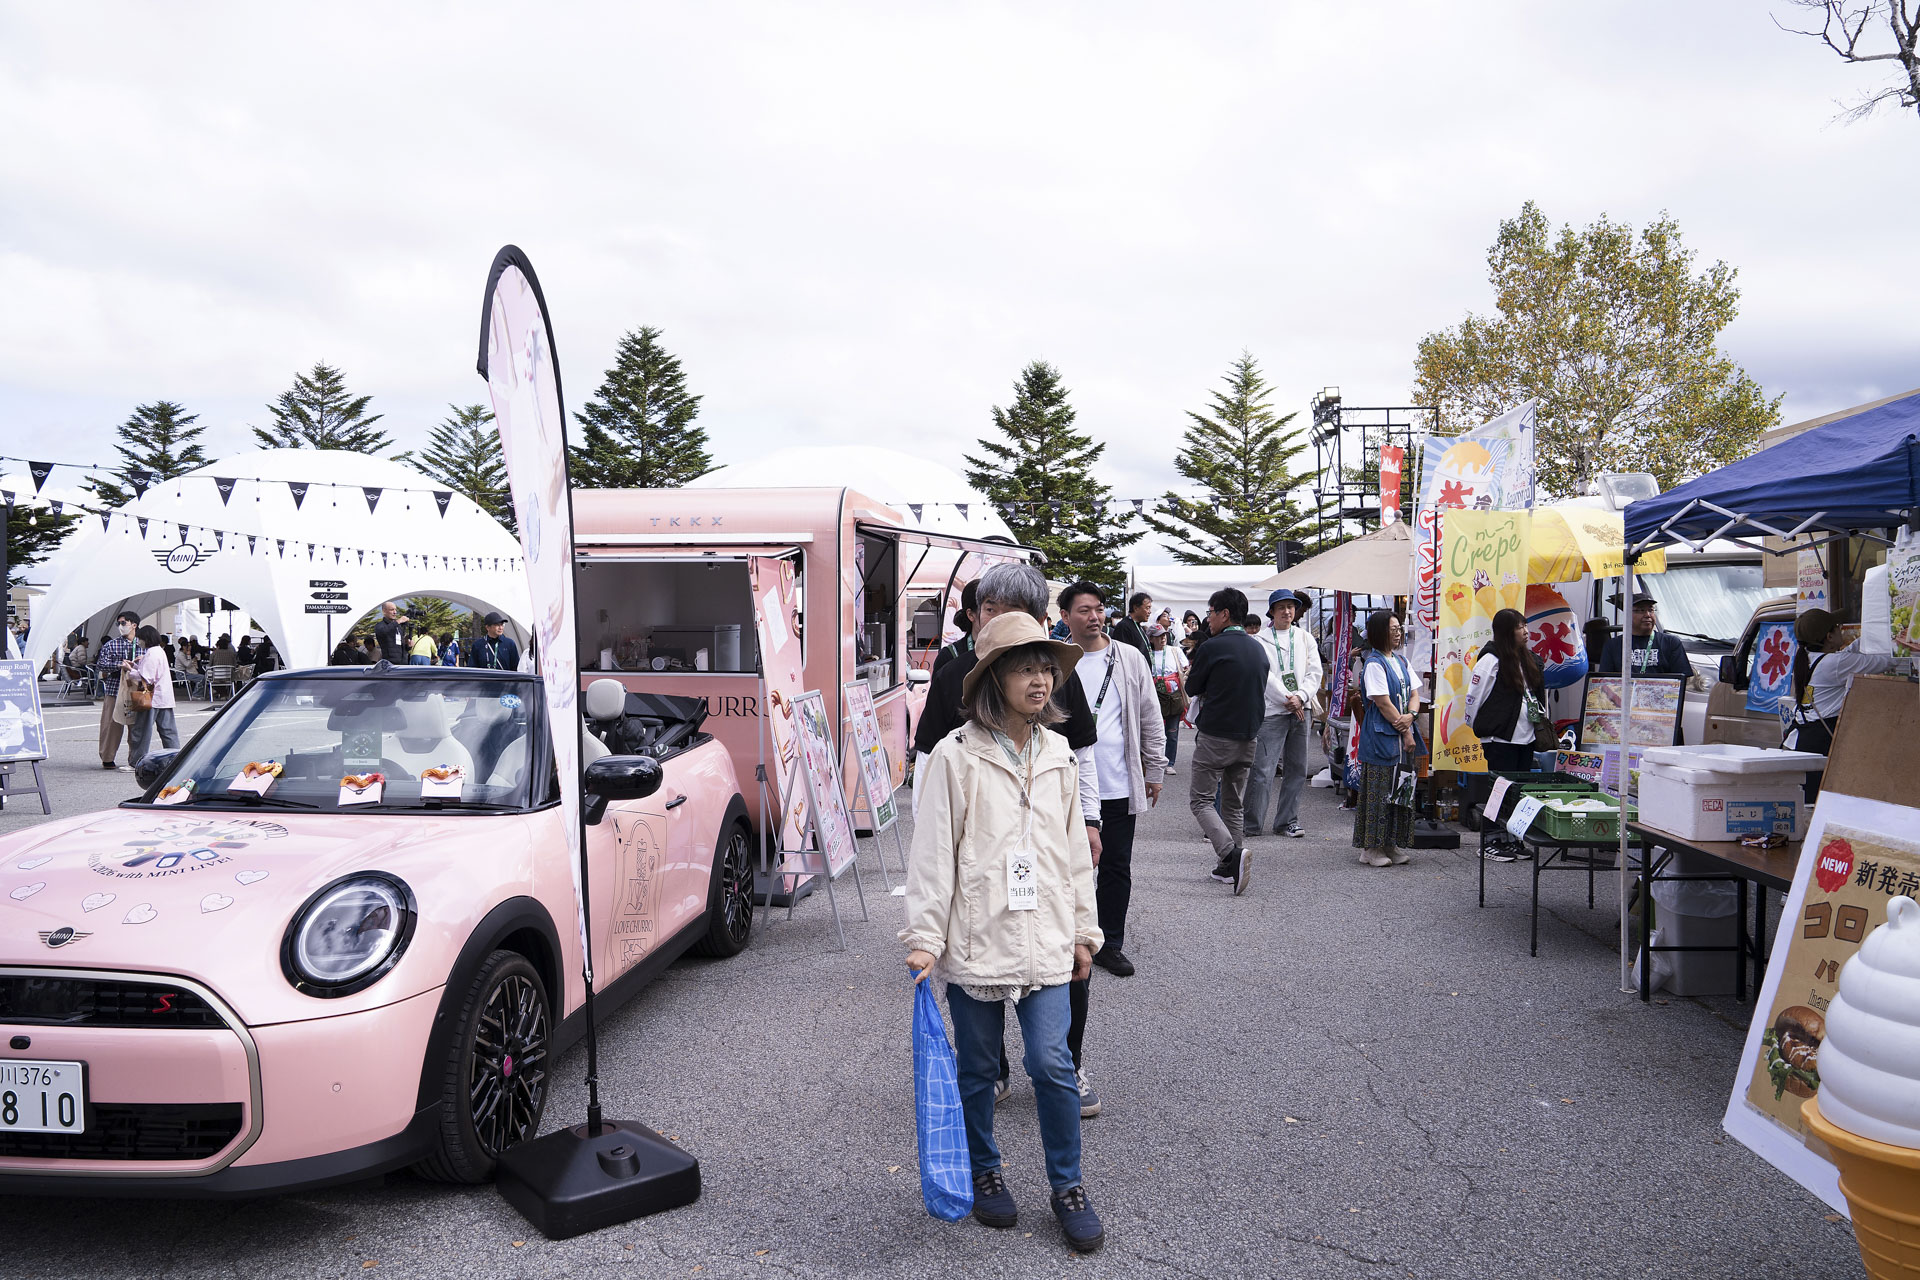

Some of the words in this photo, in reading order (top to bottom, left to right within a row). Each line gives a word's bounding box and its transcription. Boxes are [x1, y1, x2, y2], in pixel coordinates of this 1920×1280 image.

[1476, 520, 1514, 541] クレープ
[171, 554, 194, 562] MINI
[1451, 533, 1521, 578] Crepe
[1529, 621, 1577, 665] 氷
[14, 663, 31, 671] Rally
[1761, 629, 1791, 686] 氷
[1557, 752, 1603, 769] タピオカ
[116, 871, 143, 879] with
[146, 868, 186, 878] MINI
[191, 856, 235, 872] LIVE!
[1820, 856, 1848, 875] NEW!
[1010, 886, 1035, 896] 当日券
[1804, 902, 1880, 943] コロ
[51, 932, 72, 940] MINI
[152, 994, 175, 1014] S
